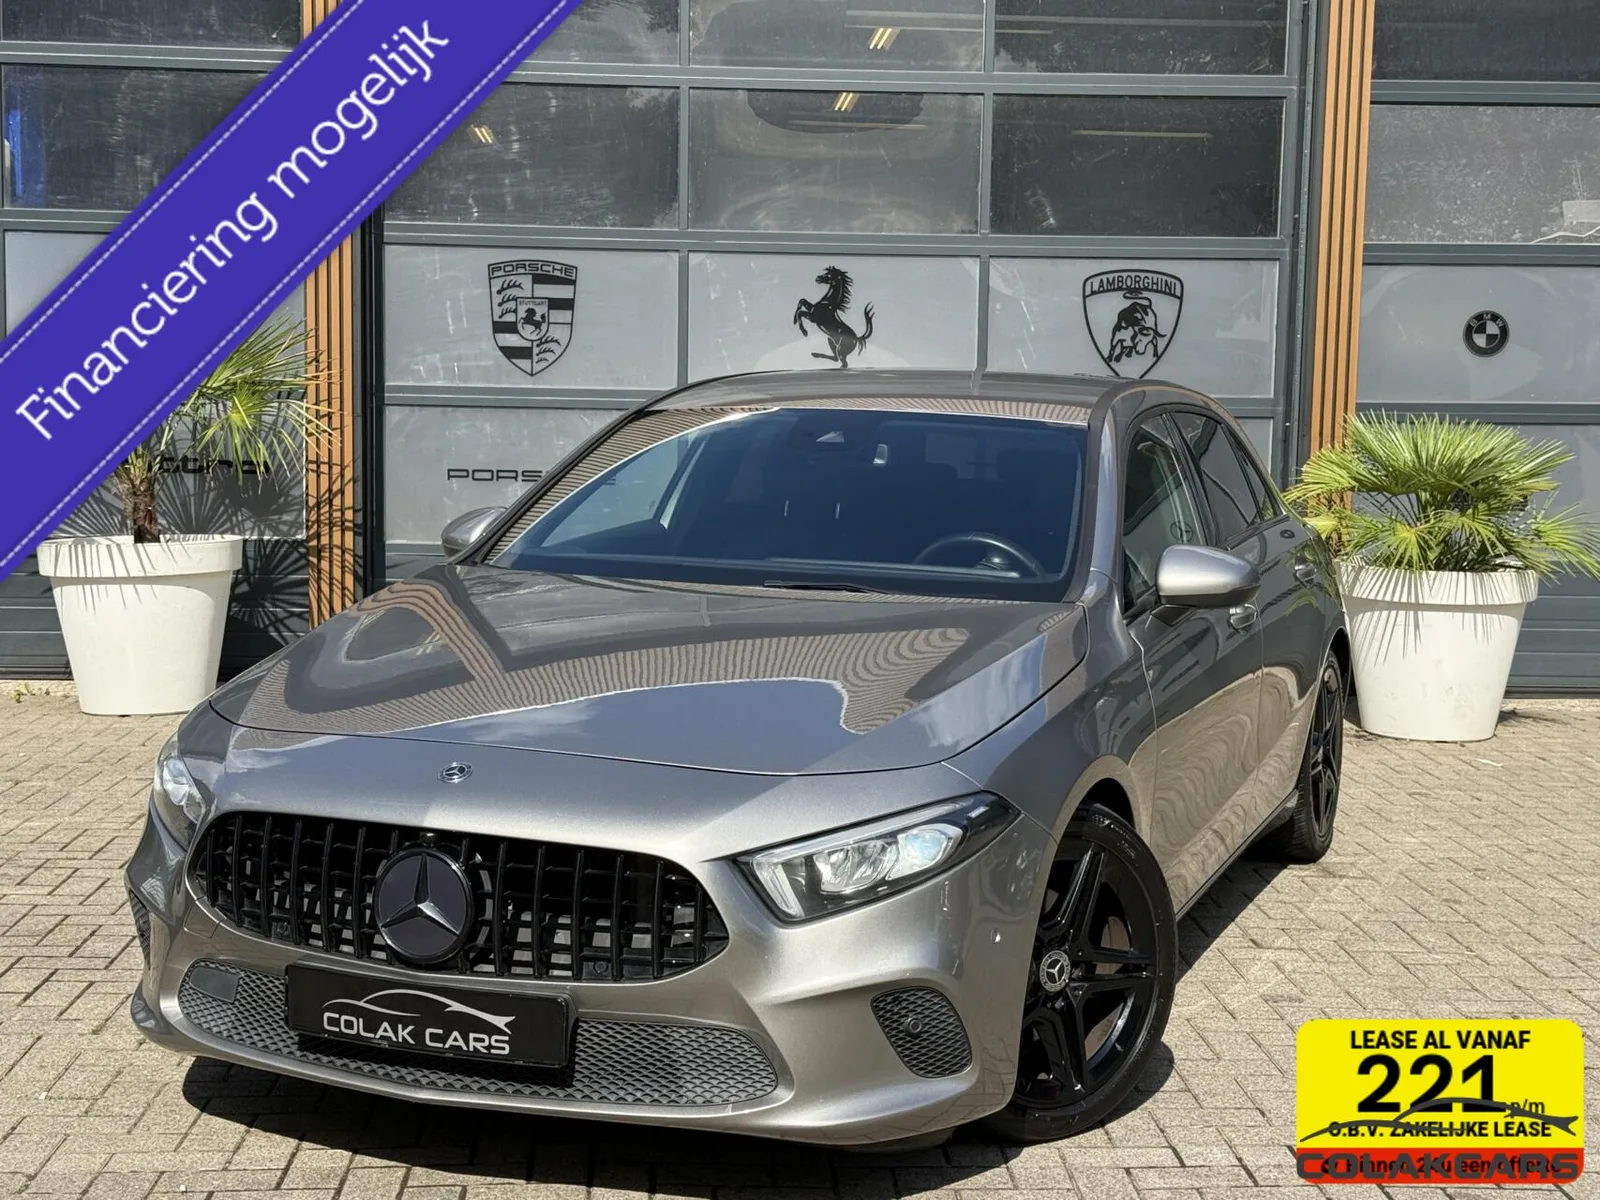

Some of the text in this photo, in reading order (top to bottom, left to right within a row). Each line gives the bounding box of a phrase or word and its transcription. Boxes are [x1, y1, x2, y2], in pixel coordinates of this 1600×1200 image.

[491, 263, 574, 278] PORSCHE
[1090, 274, 1177, 296] LAMBORGHINI
[1469, 313, 1504, 328] BMW
[447, 468, 543, 482] PORS
[323, 1012, 510, 1055] COLAK CARS
